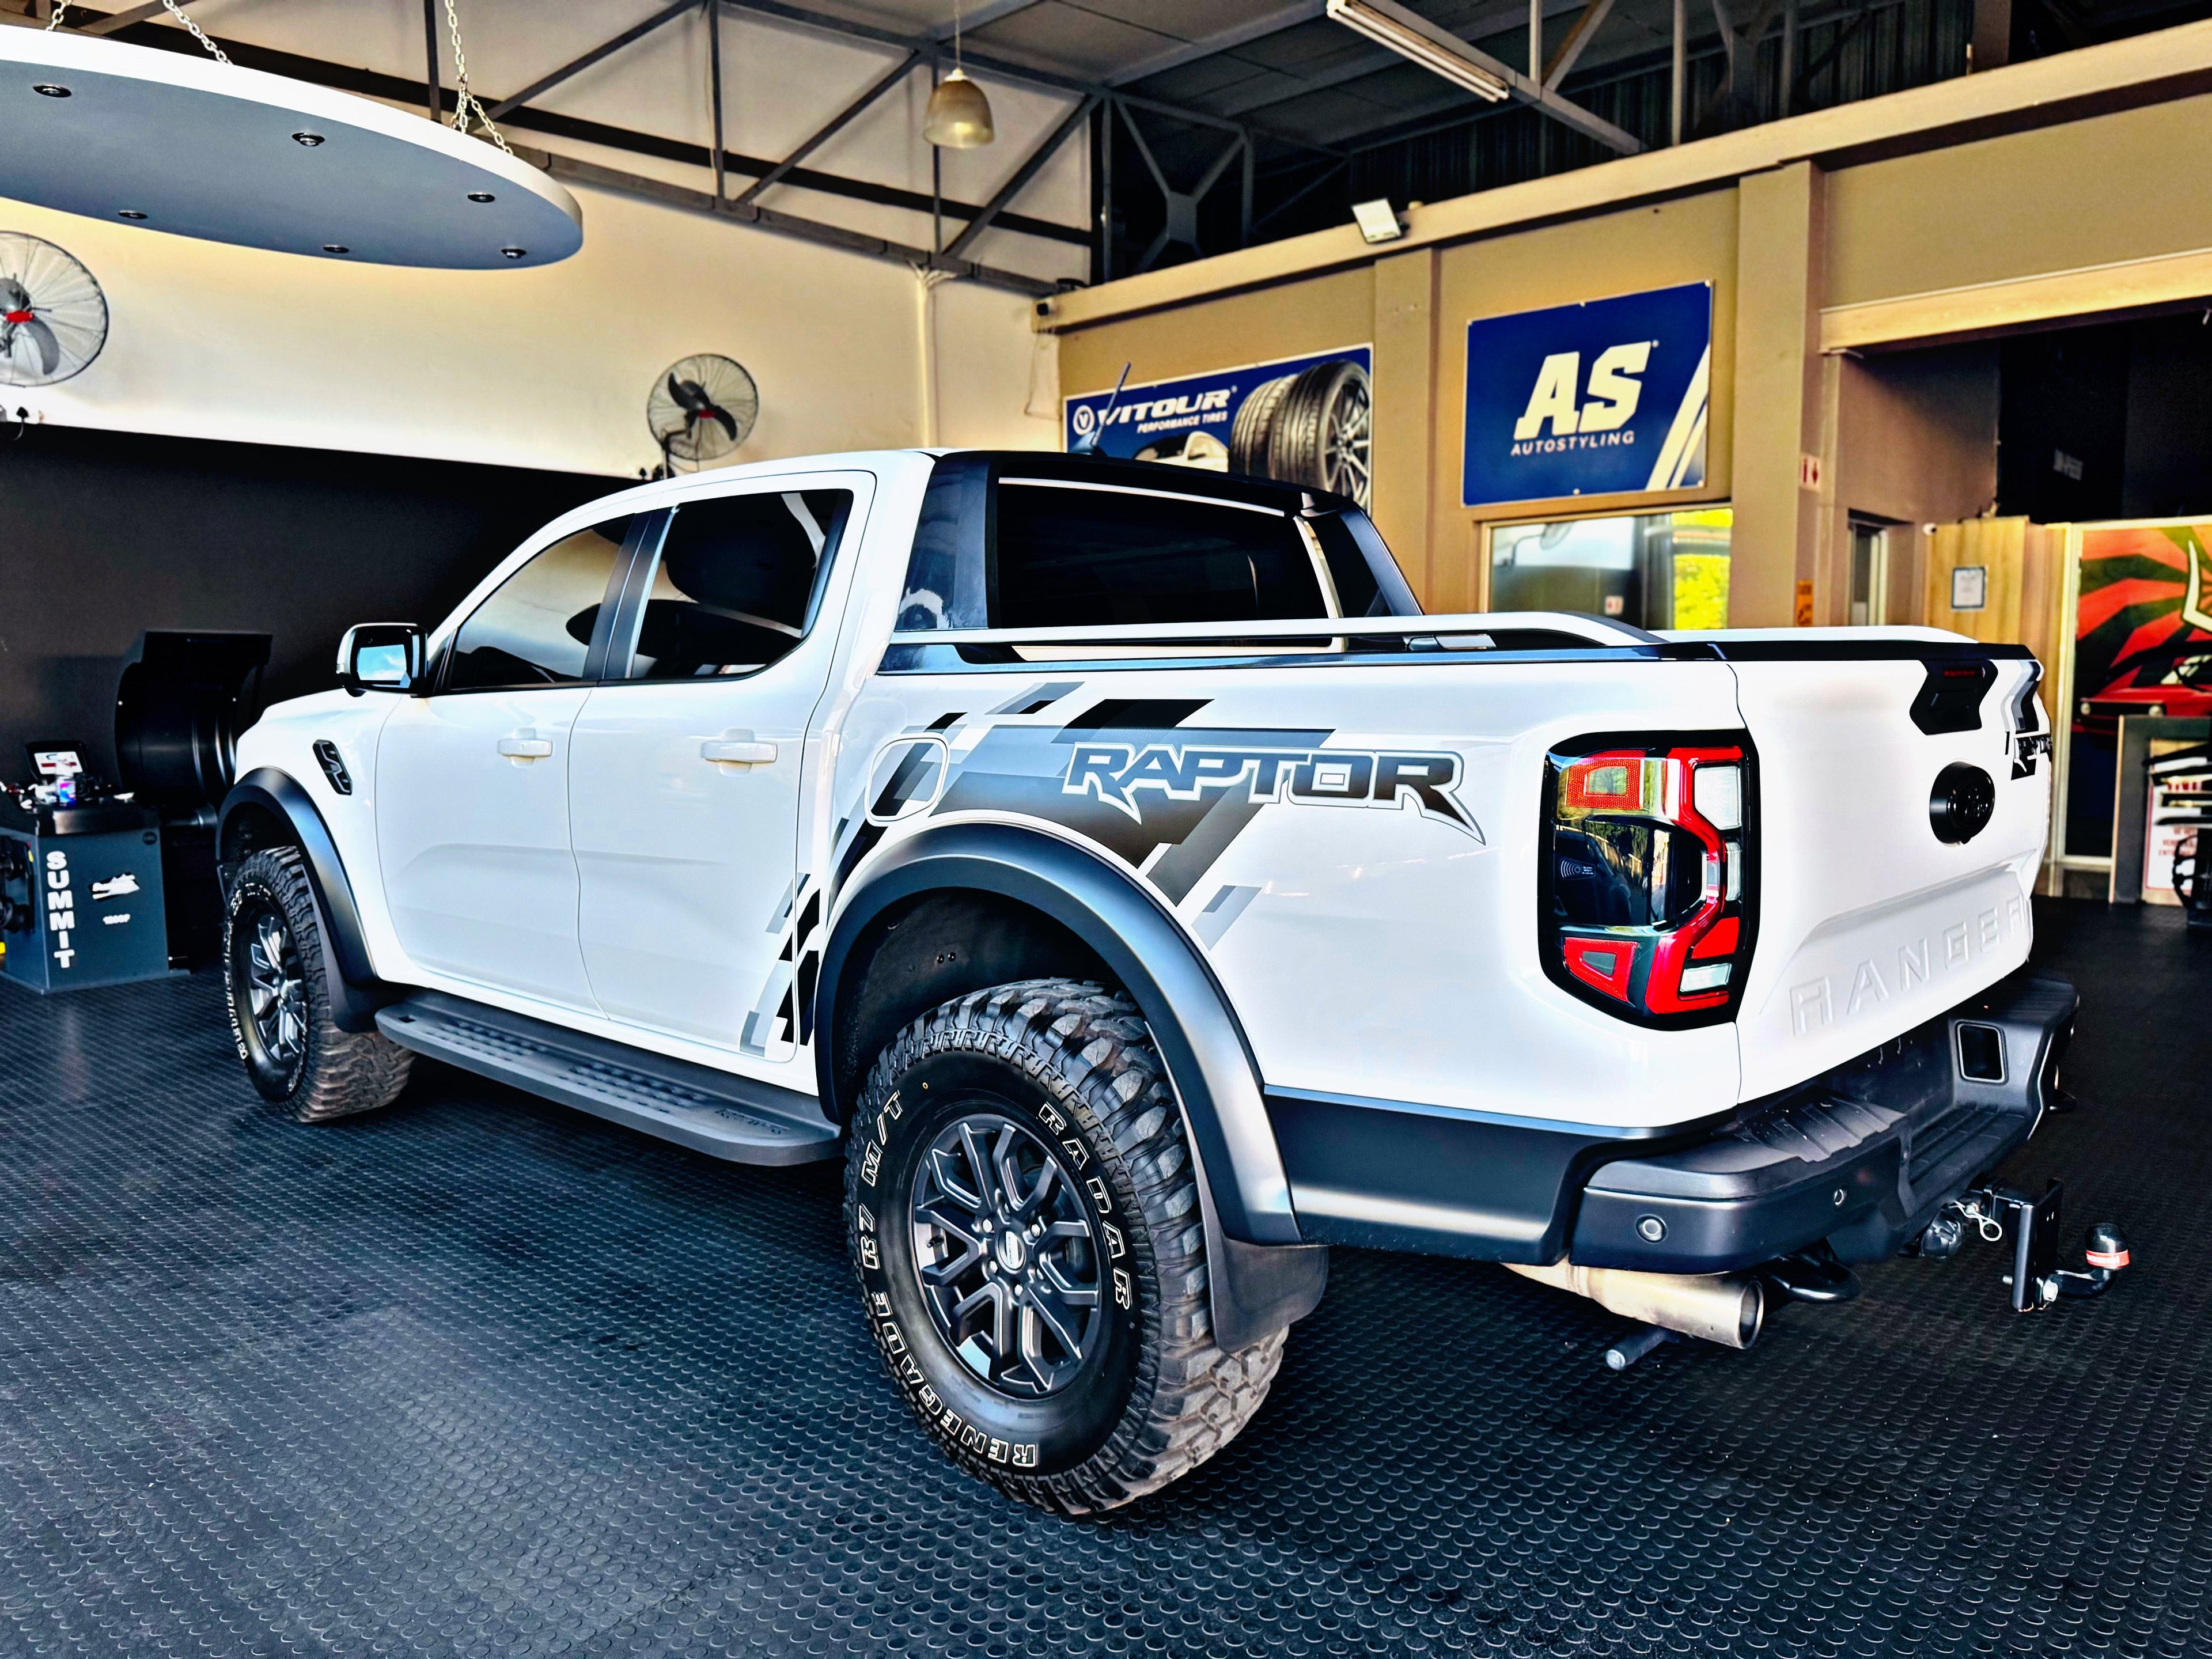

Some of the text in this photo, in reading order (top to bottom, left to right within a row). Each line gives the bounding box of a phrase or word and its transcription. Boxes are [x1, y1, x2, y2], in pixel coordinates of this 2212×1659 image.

[1097, 389, 1231, 426] VITOUR
[1137, 410, 1228, 434] PERFORMANCE TIRES
[1513, 340, 1652, 441] AS
[1510, 430, 1635, 456] AUTOSTYLING
[1062, 742, 1486, 845] RAPTOR
[46, 851, 75, 968] SUMMIT
[1789, 893, 2031, 1037] RANGER
[859, 1203, 880, 1270] R7
[1039, 1101, 1132, 1310] RADAR
[871, 1291, 1038, 1467] RENEGADE
